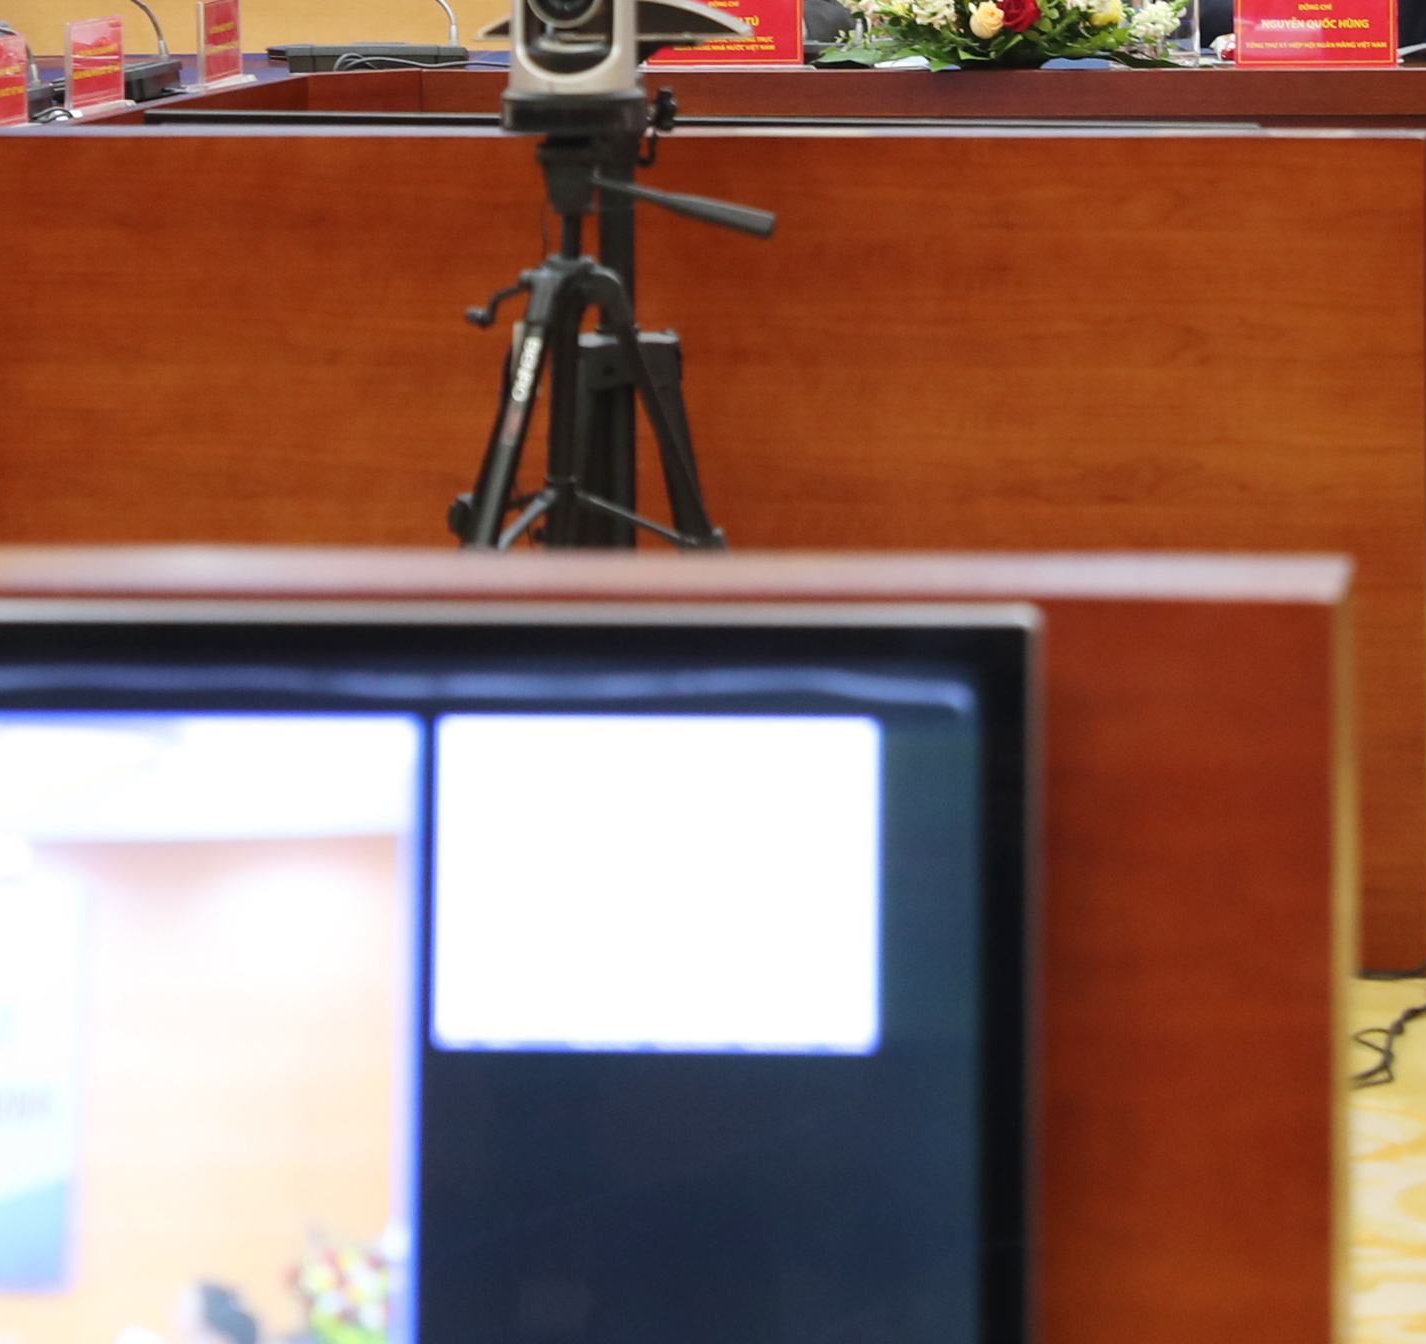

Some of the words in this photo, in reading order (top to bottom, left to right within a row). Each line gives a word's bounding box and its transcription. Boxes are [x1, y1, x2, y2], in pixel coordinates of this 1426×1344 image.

[1261, 16, 1305, 29] NGUYỄN
[1306, 17, 1337, 30] QUỐC
[1338, 17, 1370, 29] HÙNG
